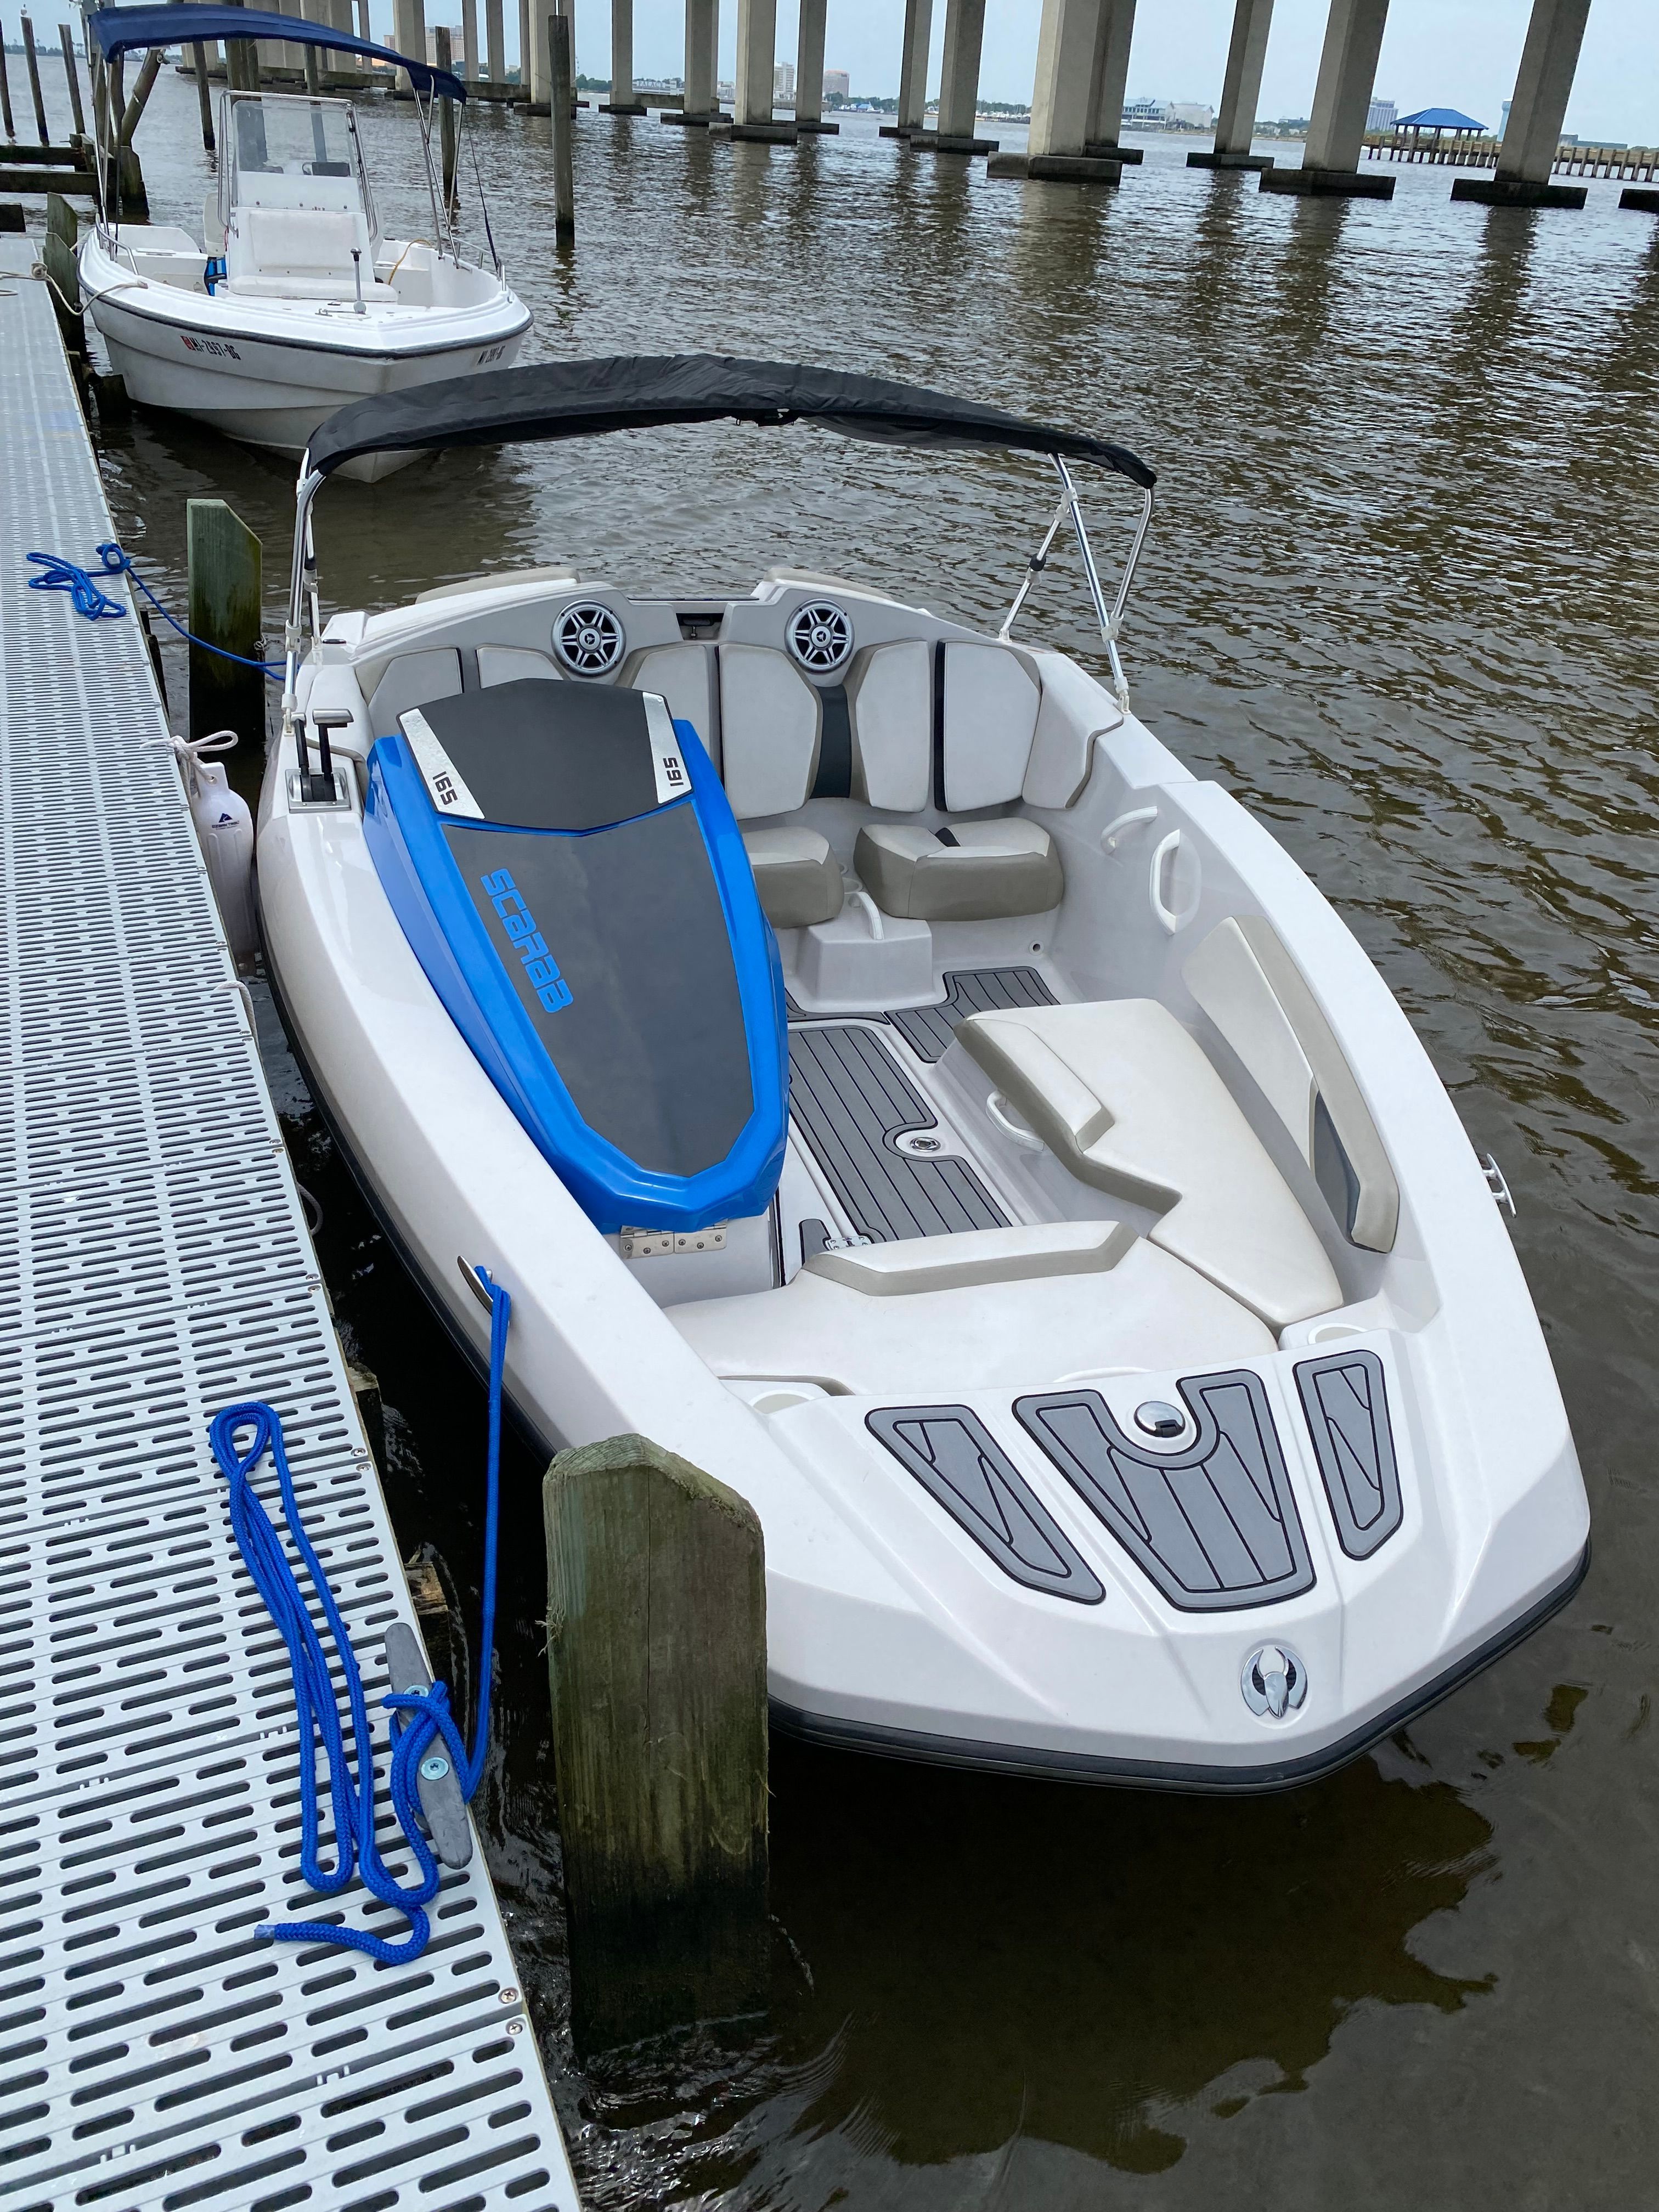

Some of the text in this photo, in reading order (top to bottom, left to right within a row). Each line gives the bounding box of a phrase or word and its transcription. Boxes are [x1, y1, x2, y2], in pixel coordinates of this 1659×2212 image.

[638, 80, 663, 88] PALACE
[432, 771, 458, 805] 165
[663, 757, 684, 787] 165
[480, 868, 574, 1013] SCARAB
